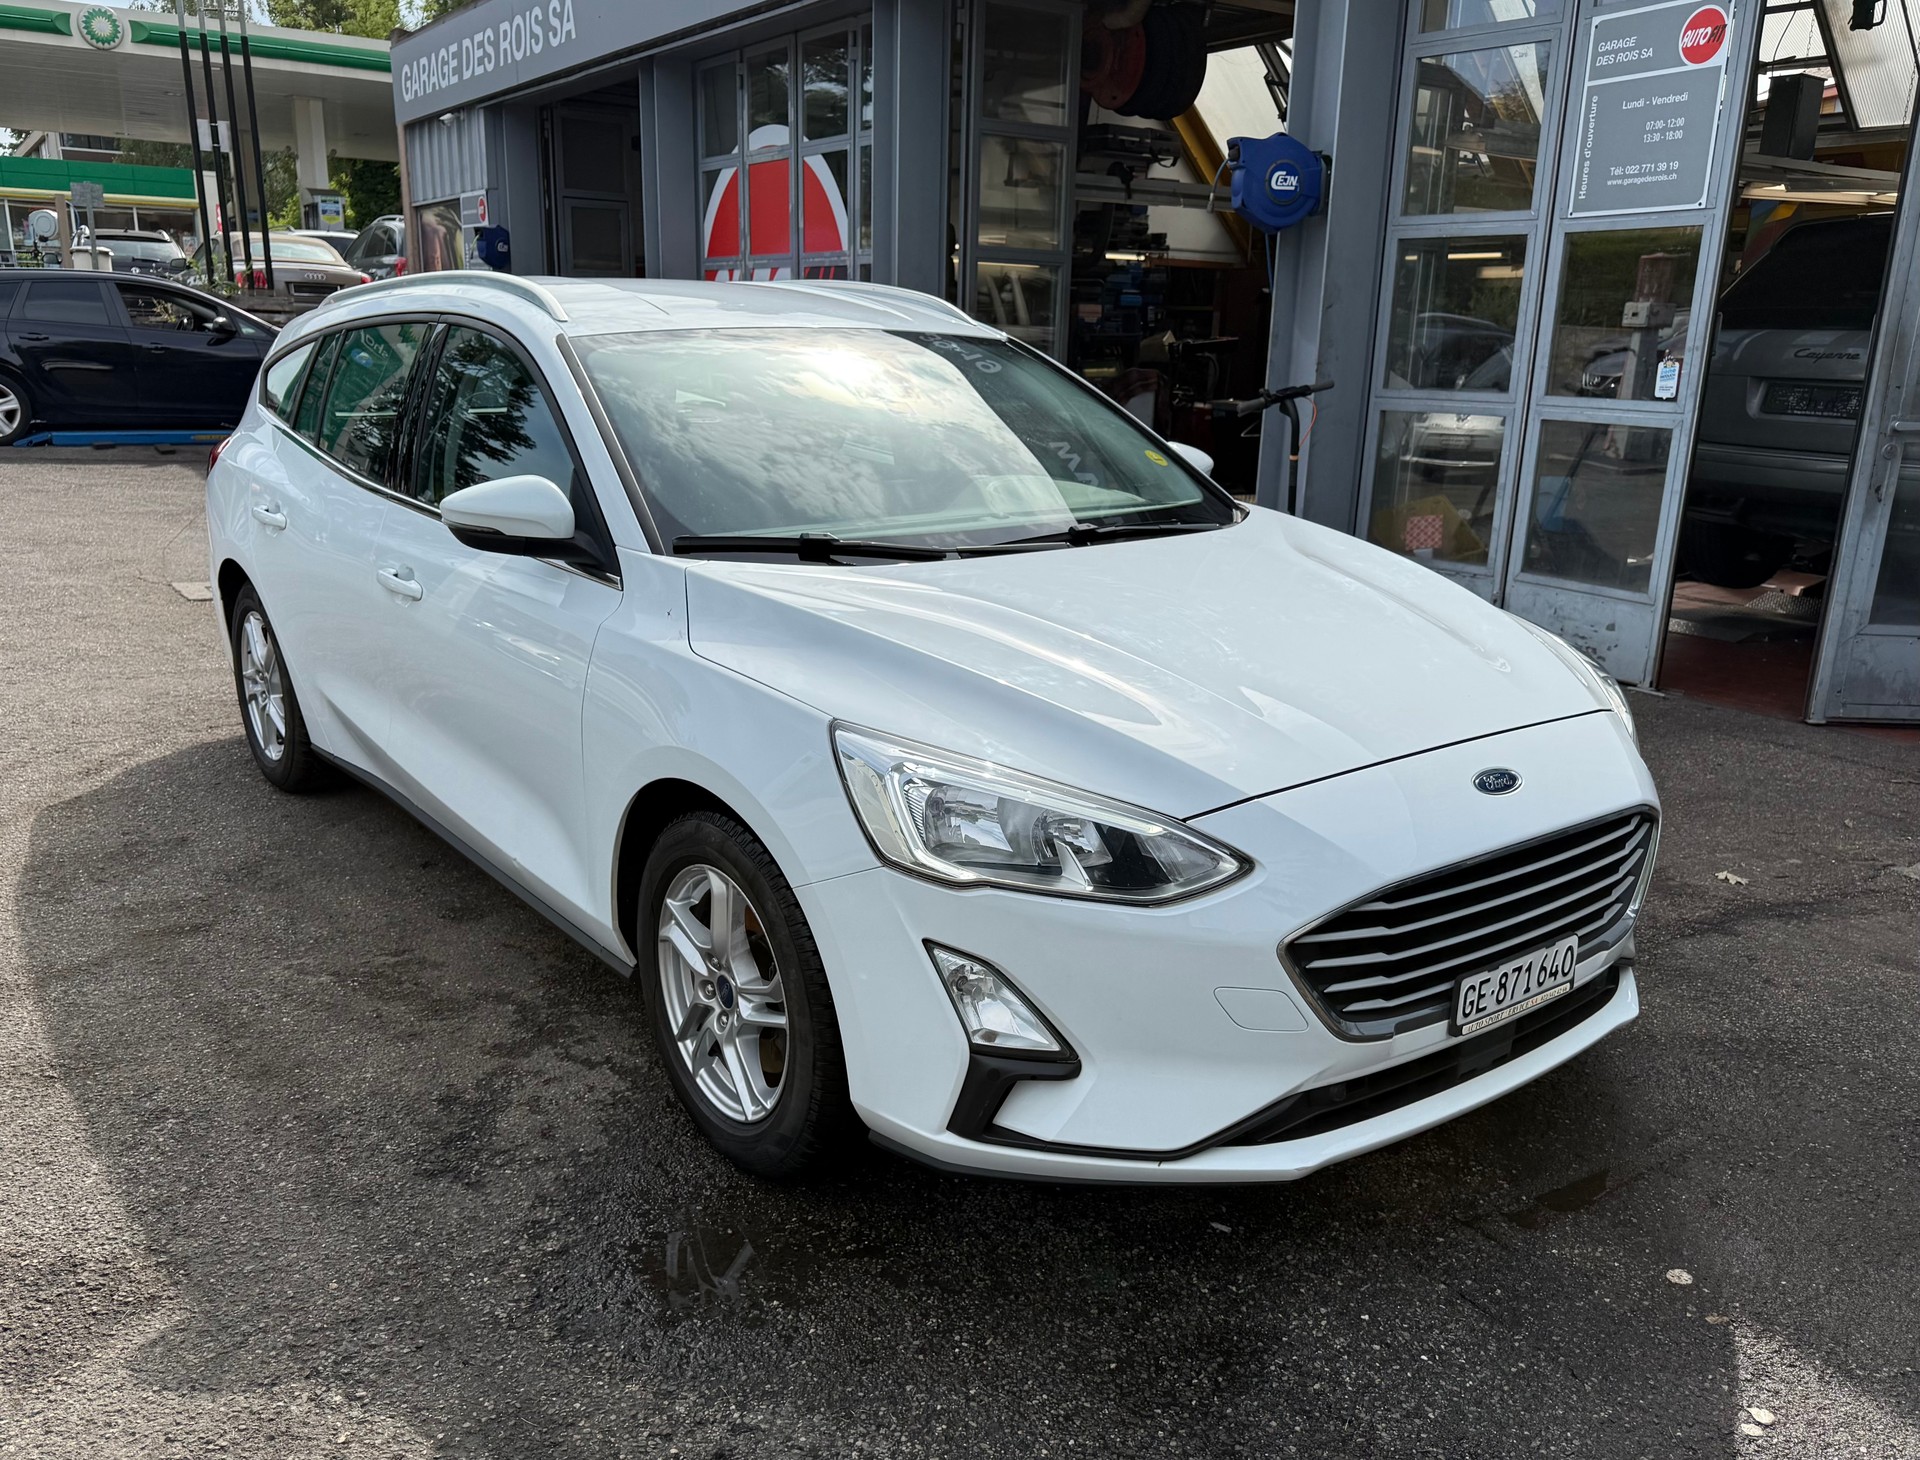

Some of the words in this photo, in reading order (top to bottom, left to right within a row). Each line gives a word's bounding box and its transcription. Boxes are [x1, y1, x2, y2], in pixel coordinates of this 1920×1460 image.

[402, 42, 459, 102] GARAGE
[462, 27, 495, 80] DES
[499, 6, 543, 67] ROIS
[548, 0, 576, 47] SA
[1598, 36, 1637, 52] GARAGE
[1596, 54, 1615, 66] DES
[1616, 50, 1639, 63] ROIS
[1640, 47, 1653, 59] SA
[1622, 98, 1644, 109] Lundi
[1652, 92, 1688, 106] Vendredi
[1584, 95, 1598, 158] d'ouverture
[1667, 117, 1685, 128] 12:00
[1643, 133, 1660, 143] 13:30
[1665, 130, 1683, 140] 18:00
[1610, 165, 1624, 176] Tél:
[1625, 164, 1639, 174] 022
[1641, 163, 1655, 173] 771
[1656, 162, 1667, 171] 39
[1669, 161, 1679, 170] 19
[1271, 171, 1298, 190] CEJN
[1579, 160, 1590, 199] Heures
[1607, 173, 1677, 186] www.garagedesrois.ch
[1794, 348, 1860, 364] Cayenne
[1483, 774, 1512, 790] Ford
